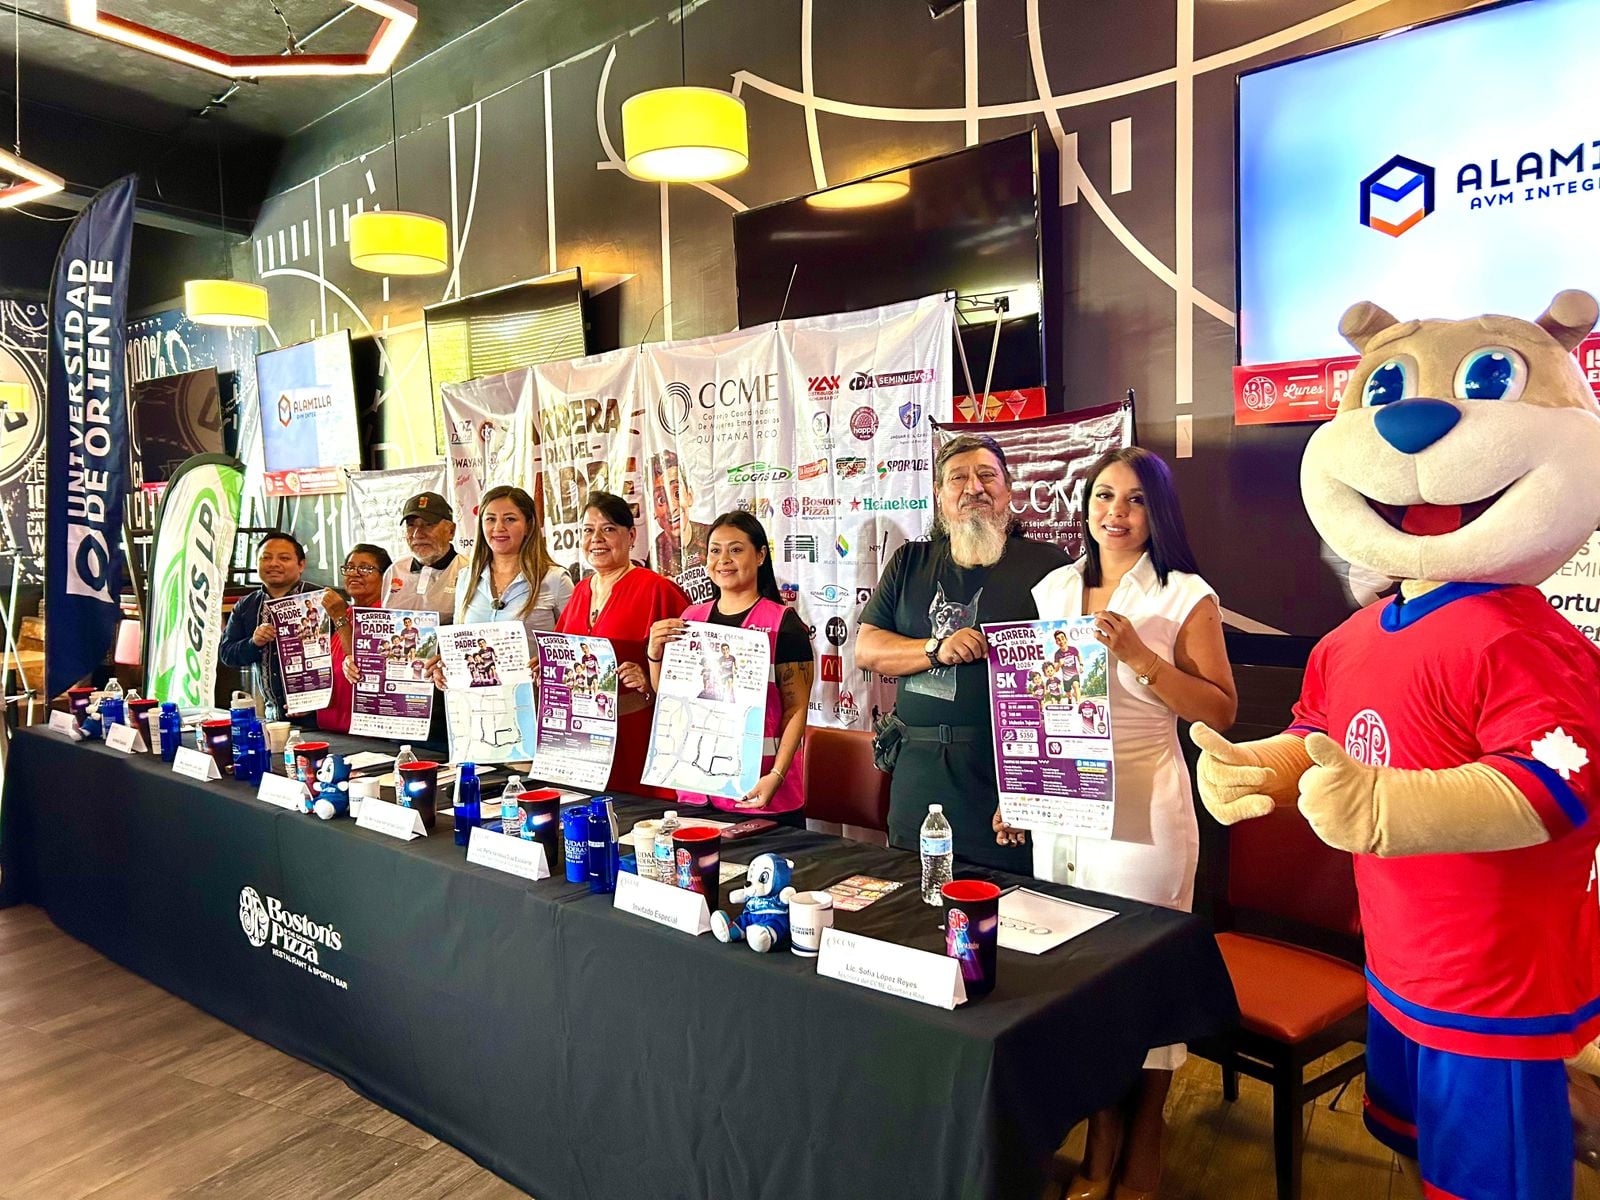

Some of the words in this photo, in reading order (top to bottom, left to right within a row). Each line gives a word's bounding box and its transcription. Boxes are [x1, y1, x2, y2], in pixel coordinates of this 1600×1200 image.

[1470, 192, 1514, 210] AVM
[1525, 176, 1600, 202] INTEG
[83, 259, 114, 457] ORIENTE
[66, 258, 88, 518] UNIVERSIDAD
[698, 373, 779, 409] CCME
[849, 375, 875, 391] CDA
[1283, 383, 1325, 400] Lunes
[294, 395, 333, 413] ALAMILLA
[887, 458, 929, 472] SPORADE
[772, 471, 787, 481] LP
[84, 468, 109, 523] DE
[802, 506, 830, 516] Pizza
[863, 497, 928, 511] Heineken
[675, 567, 706, 586] CARRERA
[681, 581, 714, 602] ADRE
[278, 608, 303, 622] PADRE
[361, 613, 392, 621] CARRERA
[278, 625, 291, 637] 5K
[362, 623, 395, 634] PADRE
[995, 629, 1037, 643] CARRERA
[356, 639, 372, 650] 5K
[454, 639, 478, 650] PADRE
[543, 637, 570, 646] CARRERA
[546, 648, 576, 661] PADRE
[998, 644, 1046, 664] PADRE
[543, 666, 557, 679] 5K
[996, 672, 1018, 689] 5K
[632, 902, 654, 918] Invitado
[654, 908, 678, 925] Especial
[266, 895, 343, 952] Boston's
[270, 920, 320, 965] Pizza
[876, 971, 897, 985] López
[896, 977, 918, 989] Reyes
